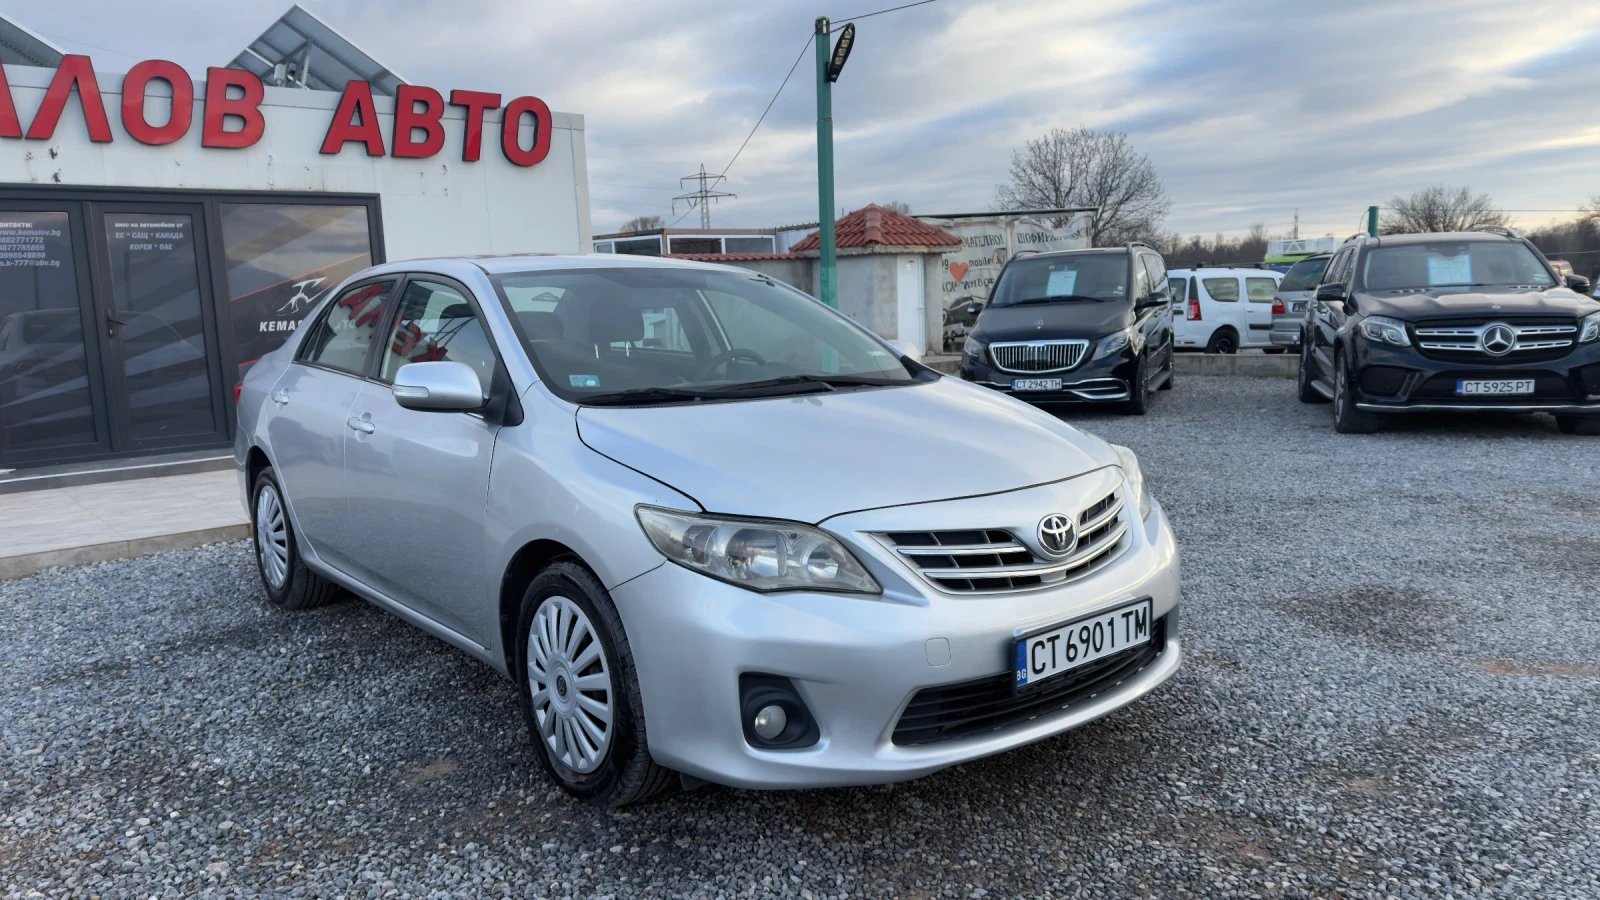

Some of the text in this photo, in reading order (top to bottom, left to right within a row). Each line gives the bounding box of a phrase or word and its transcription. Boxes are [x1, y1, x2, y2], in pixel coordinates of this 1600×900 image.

[0, 54, 552, 167] ЛОВ АВТО
[0, 236, 44, 244] 882771772
[131, 232, 149, 240] САЩ
[155, 232, 184, 240] КАНАДА
[129, 243, 153, 251] КОРЕЯ
[259, 319, 303, 332] KEMA
[1016, 379, 1061, 389] CT 2942 TH
[1464, 382, 1482, 393] CT
[1483, 381, 1514, 393] 5925
[1515, 381, 1533, 392] PT
[1031, 606, 1147, 675] CT 6901 TM
[1016, 668, 1027, 681] BG
